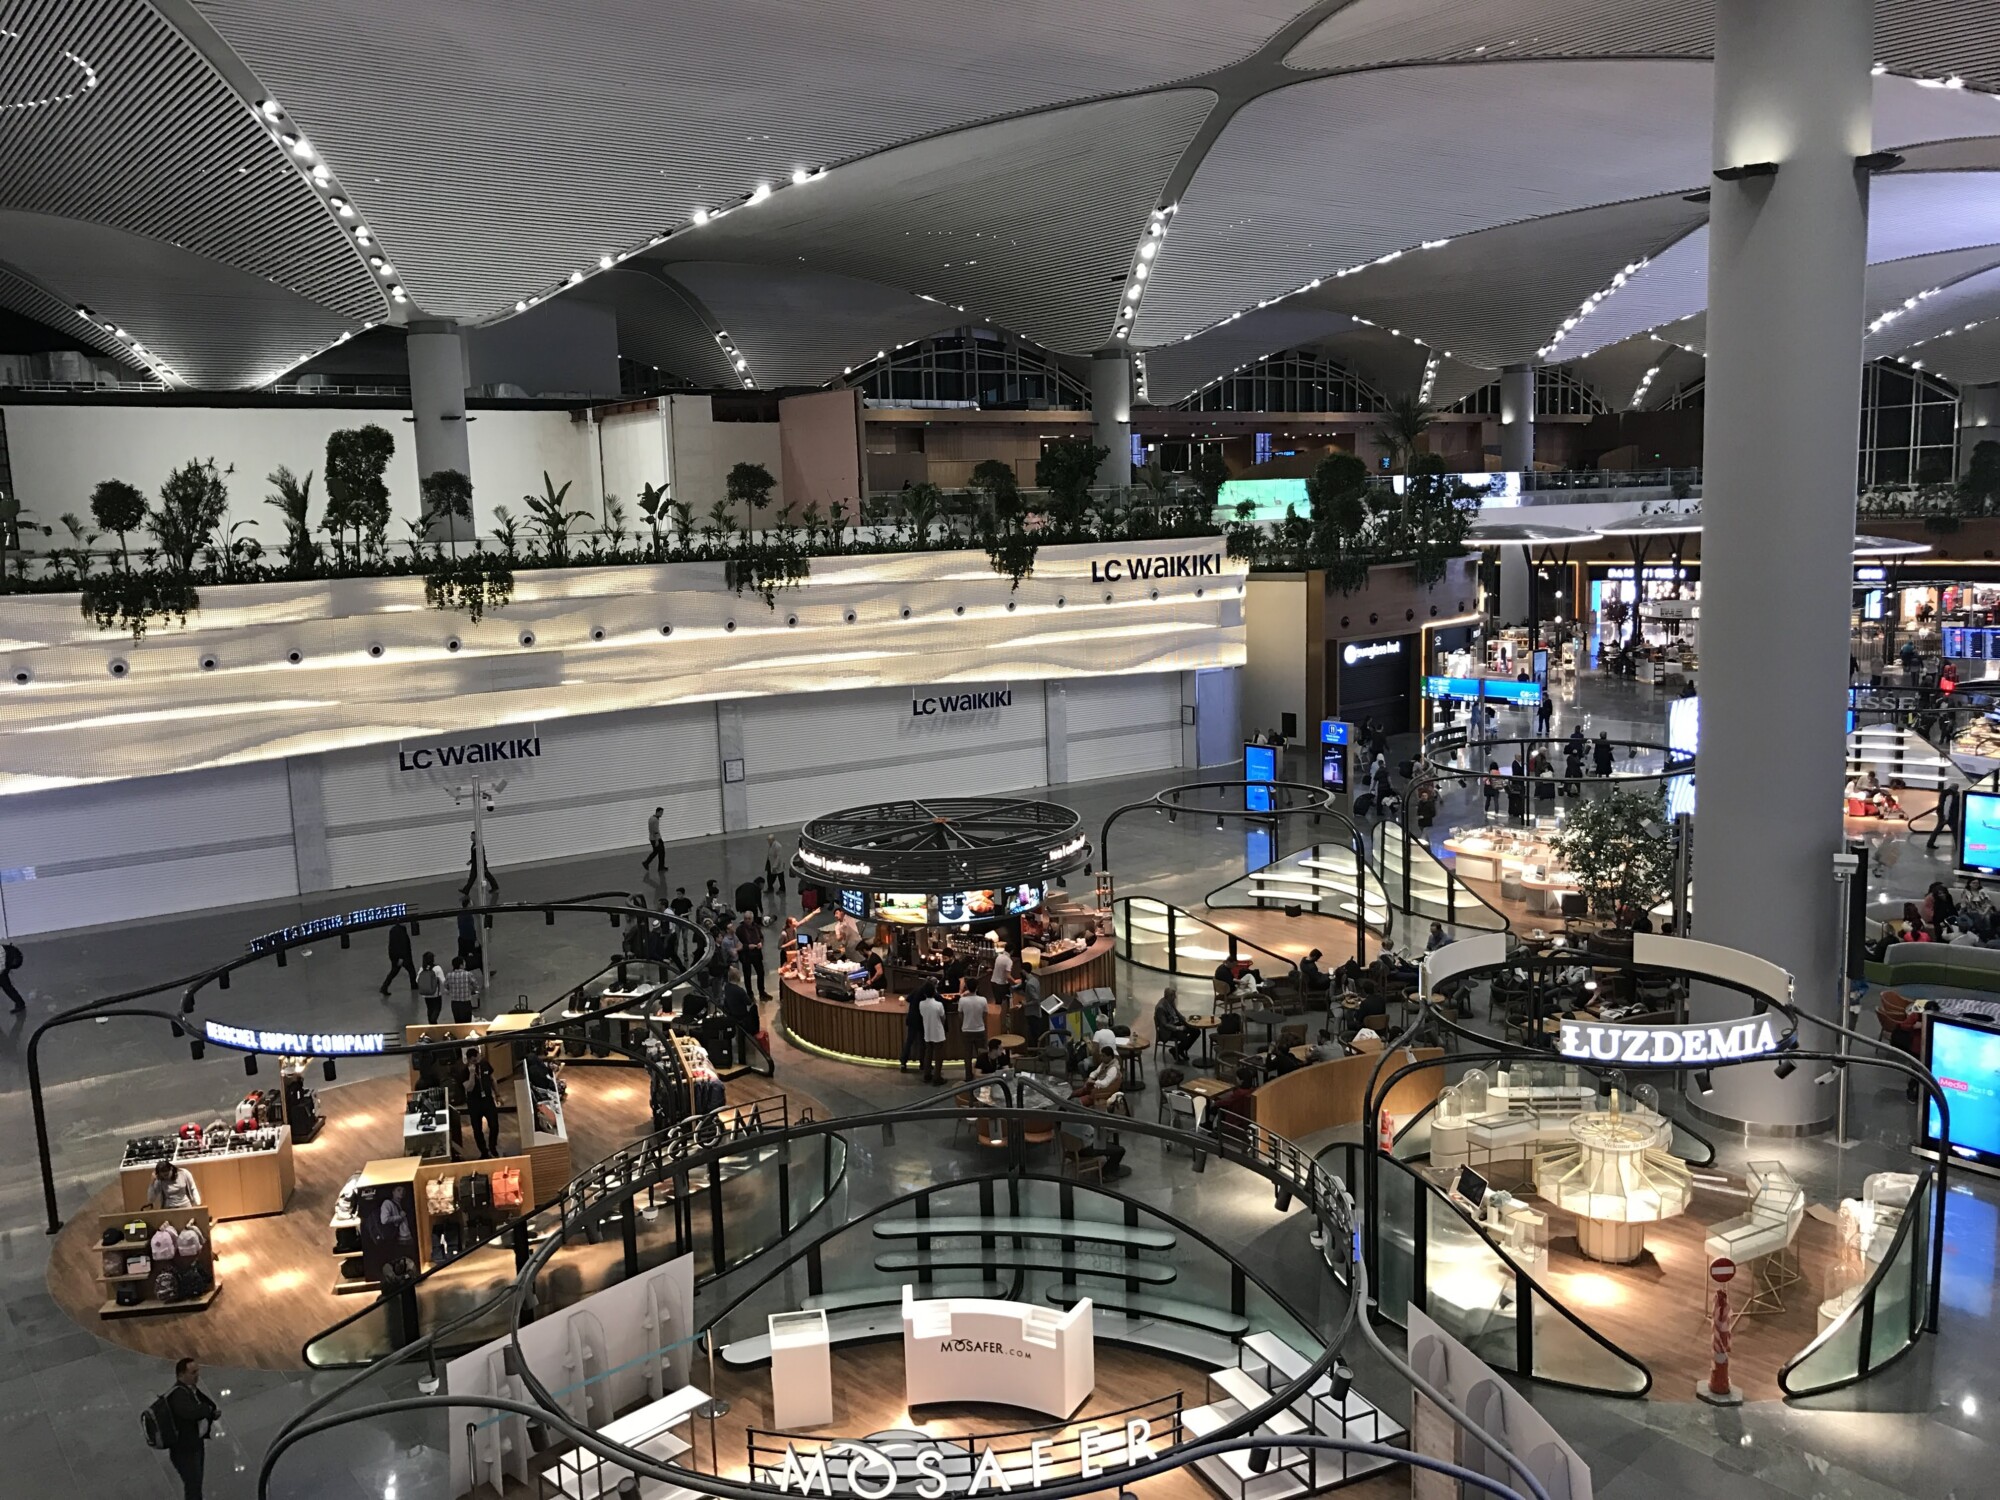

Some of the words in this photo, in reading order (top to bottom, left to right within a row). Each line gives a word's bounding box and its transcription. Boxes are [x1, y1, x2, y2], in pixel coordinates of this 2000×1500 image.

[1091, 559, 1122, 583] LC
[913, 698, 937, 716] LC
[399, 749, 433, 772] LC
[259, 1031, 309, 1052] SUPPLY
[312, 1033, 384, 1053] COMPANY
[1940, 1077, 1968, 1091] Media
[779, 1418, 1159, 1500] MOSAFER
